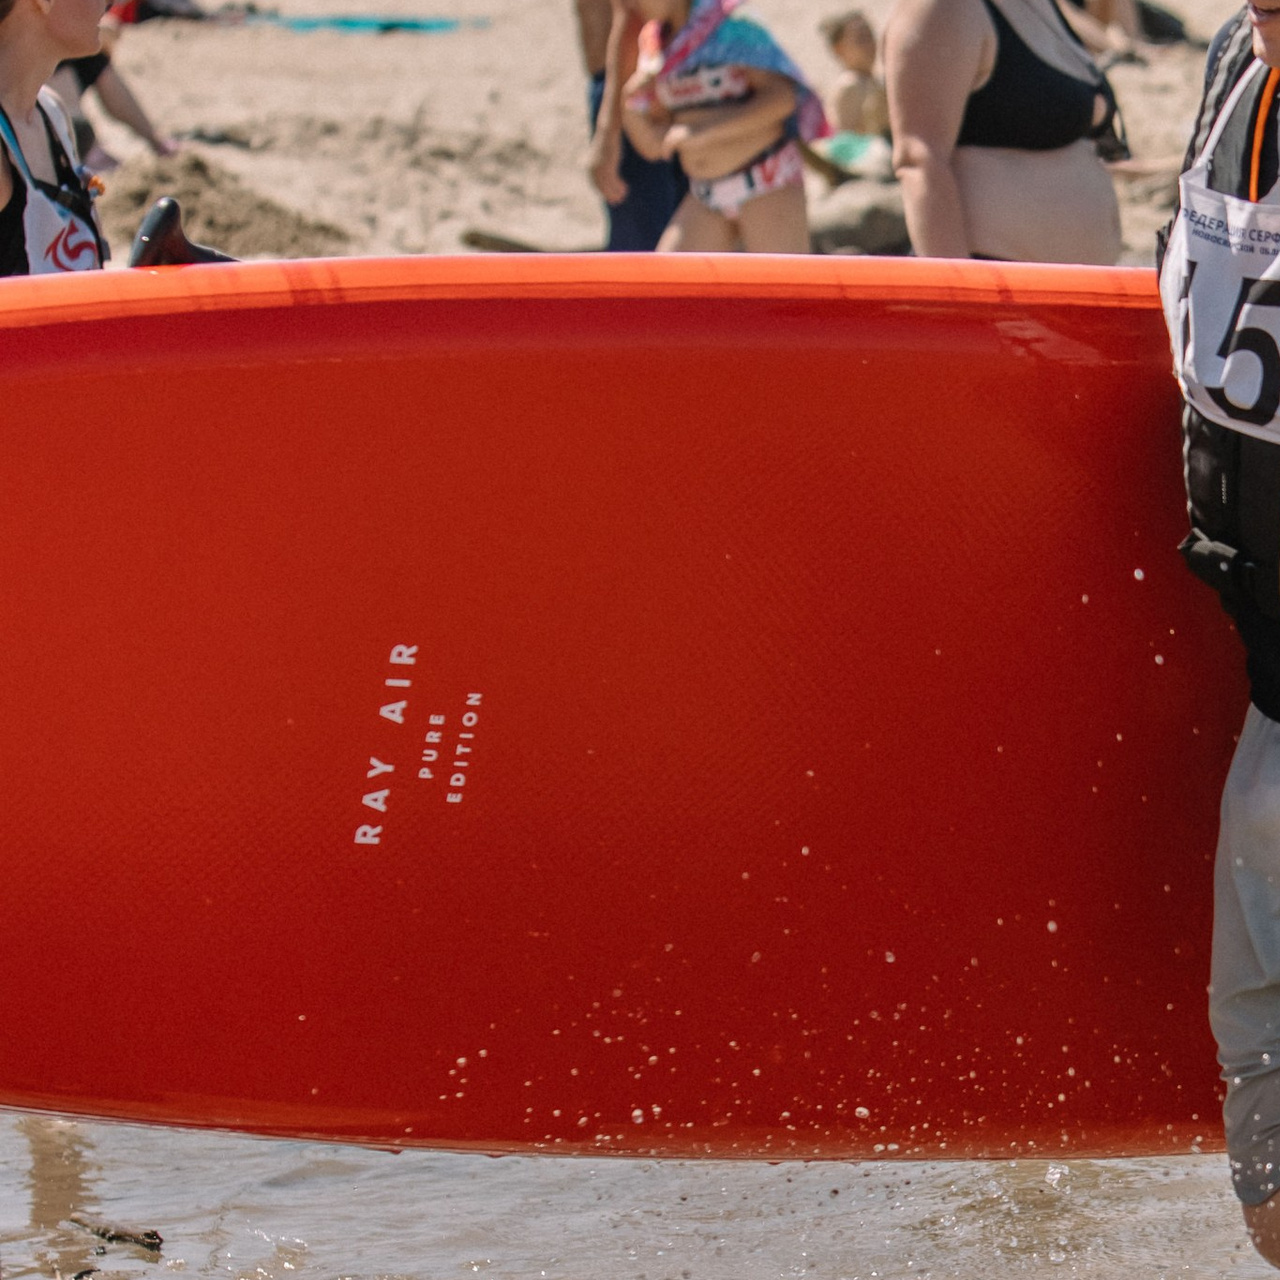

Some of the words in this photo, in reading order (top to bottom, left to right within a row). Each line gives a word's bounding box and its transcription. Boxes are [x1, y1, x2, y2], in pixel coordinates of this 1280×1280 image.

[353, 756, 395, 845] RAY
[378, 644, 419, 725] AIR
[417, 714, 446, 780] PURE
[445, 692, 483, 803] EDITION
